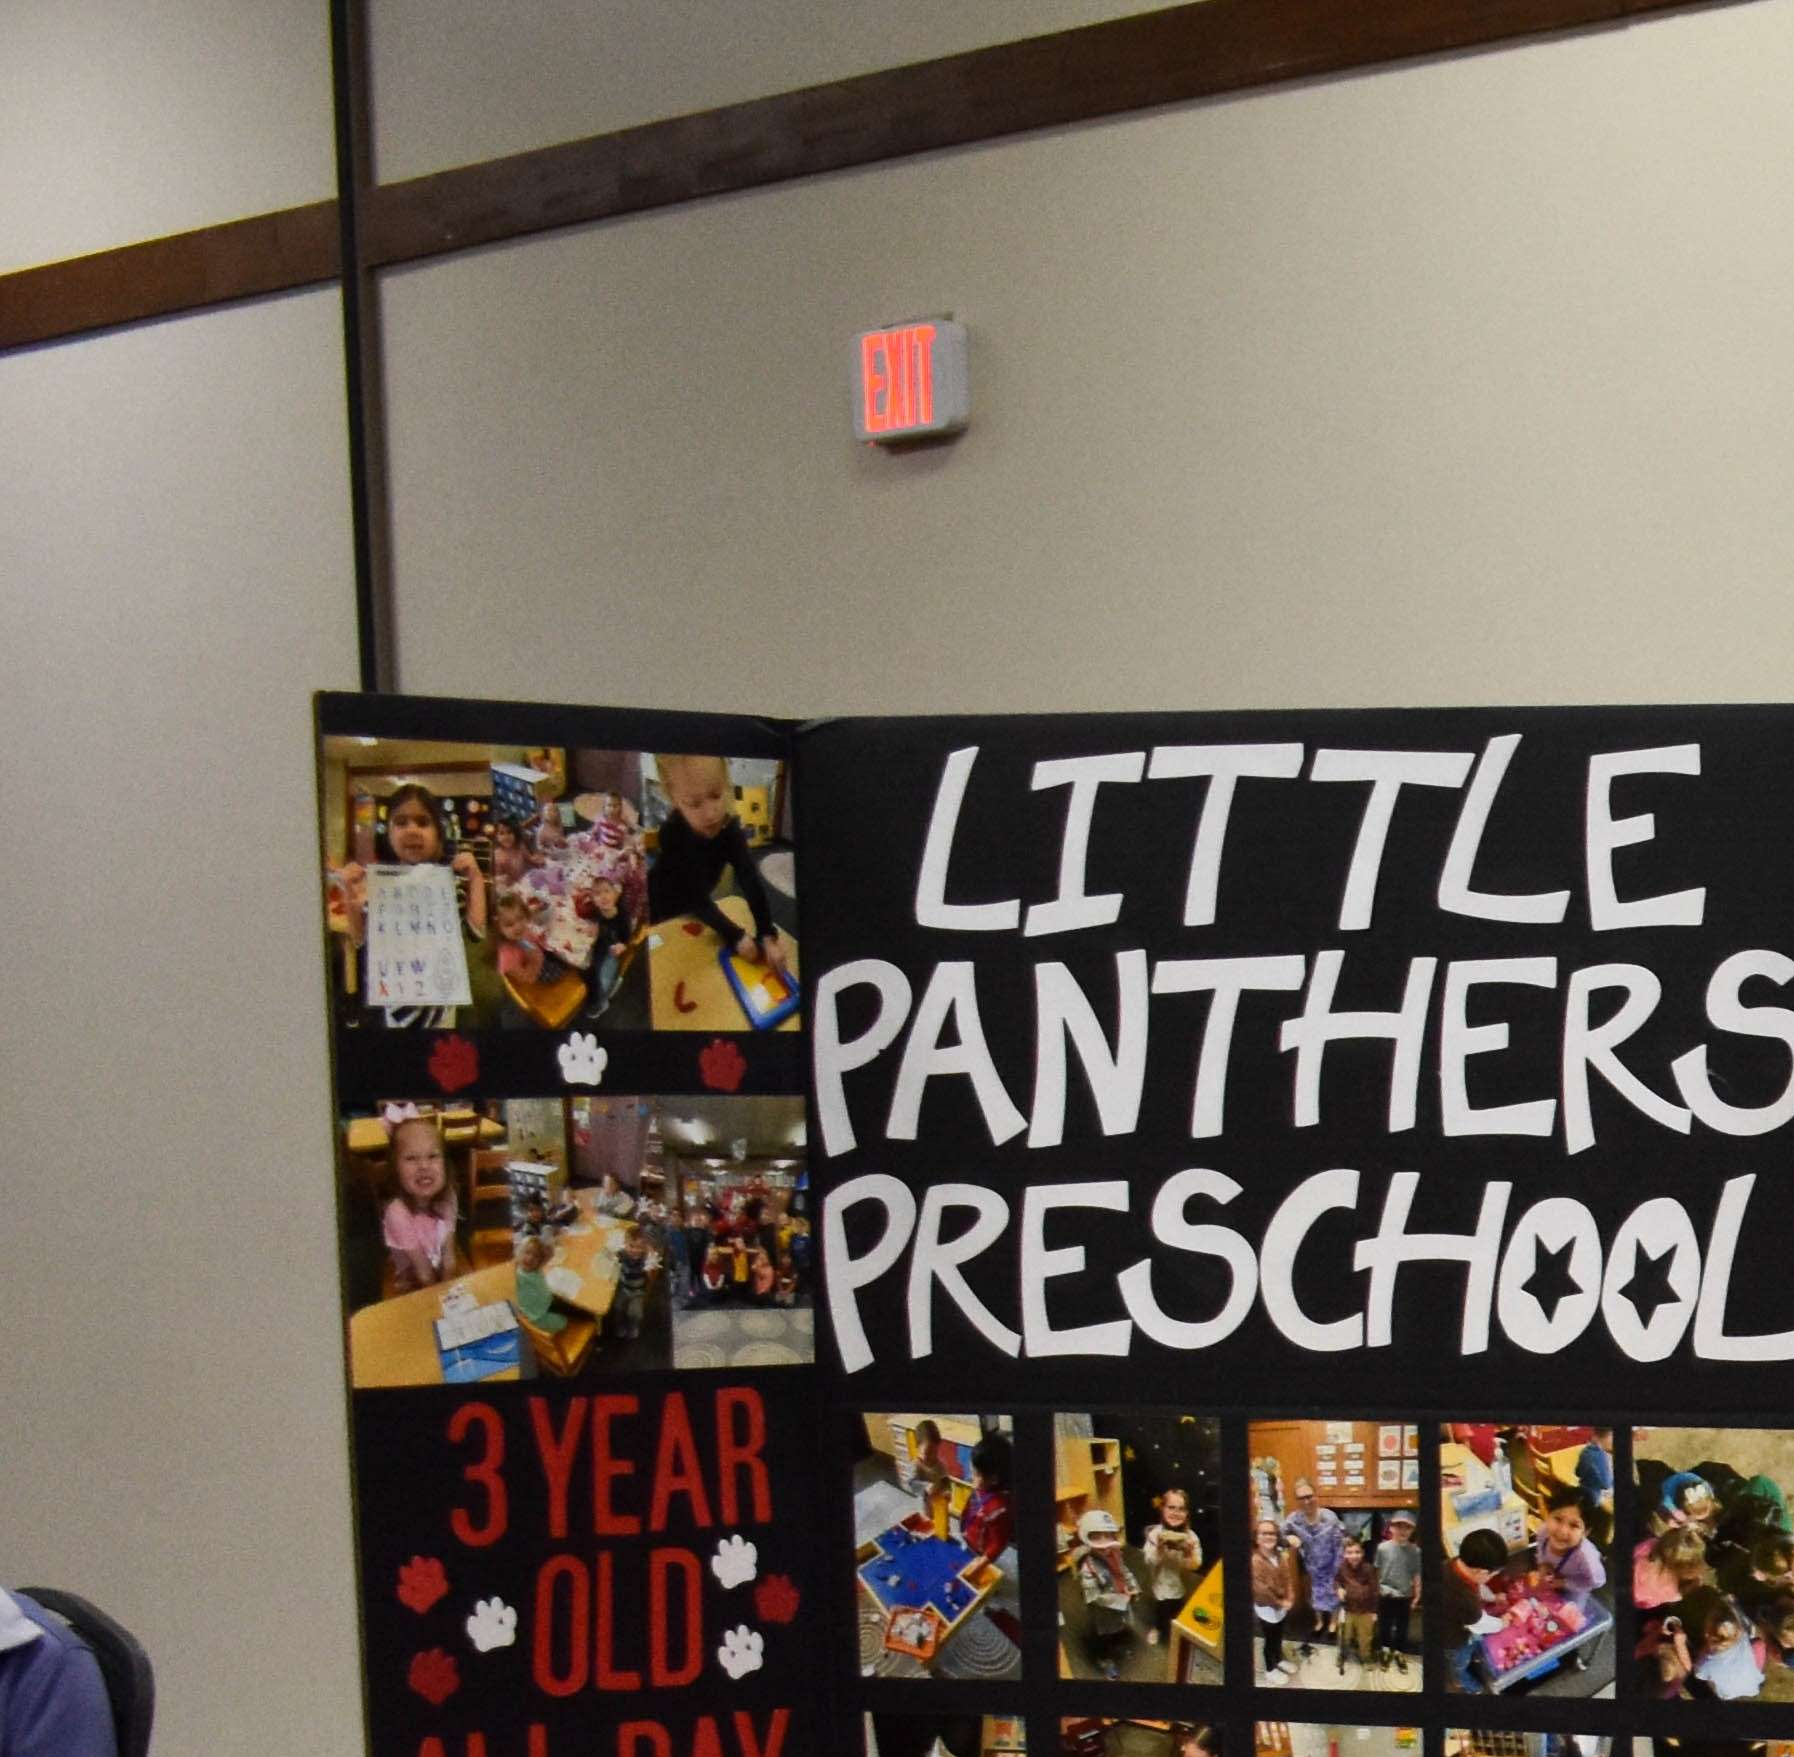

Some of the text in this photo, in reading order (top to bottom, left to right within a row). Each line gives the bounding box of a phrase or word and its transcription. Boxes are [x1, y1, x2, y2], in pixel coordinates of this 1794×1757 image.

[861, 325, 936, 432] EXIT
[916, 734, 1705, 936] LITTLE
[448, 1387, 772, 1547] 3 YEAR
[534, 1547, 702, 1697] OLD
